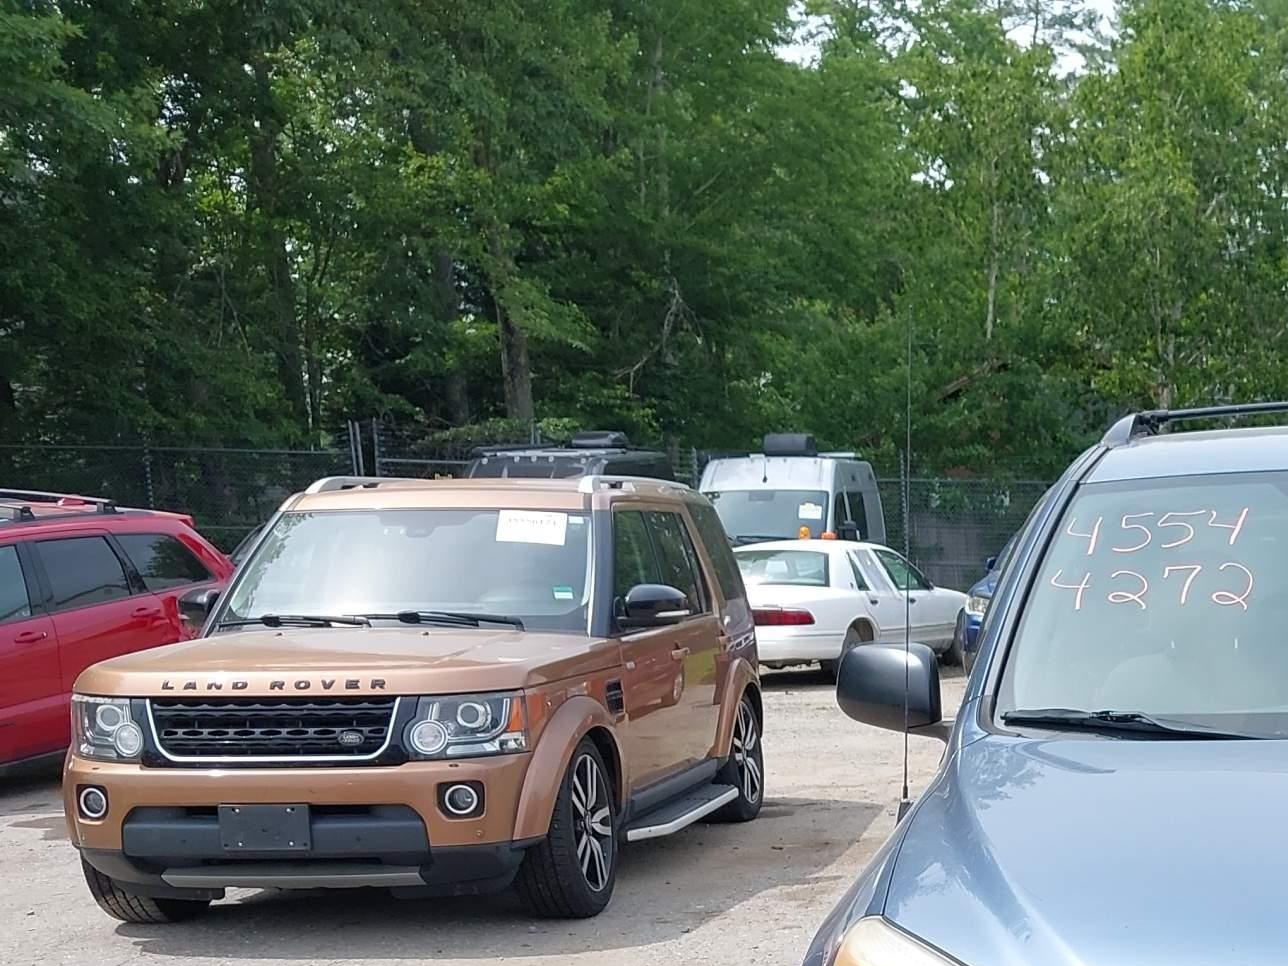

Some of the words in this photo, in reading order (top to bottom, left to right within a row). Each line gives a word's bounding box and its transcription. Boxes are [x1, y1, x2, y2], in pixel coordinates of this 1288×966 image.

[1066, 507, 1249, 556] 4554
[1050, 562, 1254, 611] 4272
[161, 680, 248, 691] LAND
[269, 679, 386, 691] ROVER
